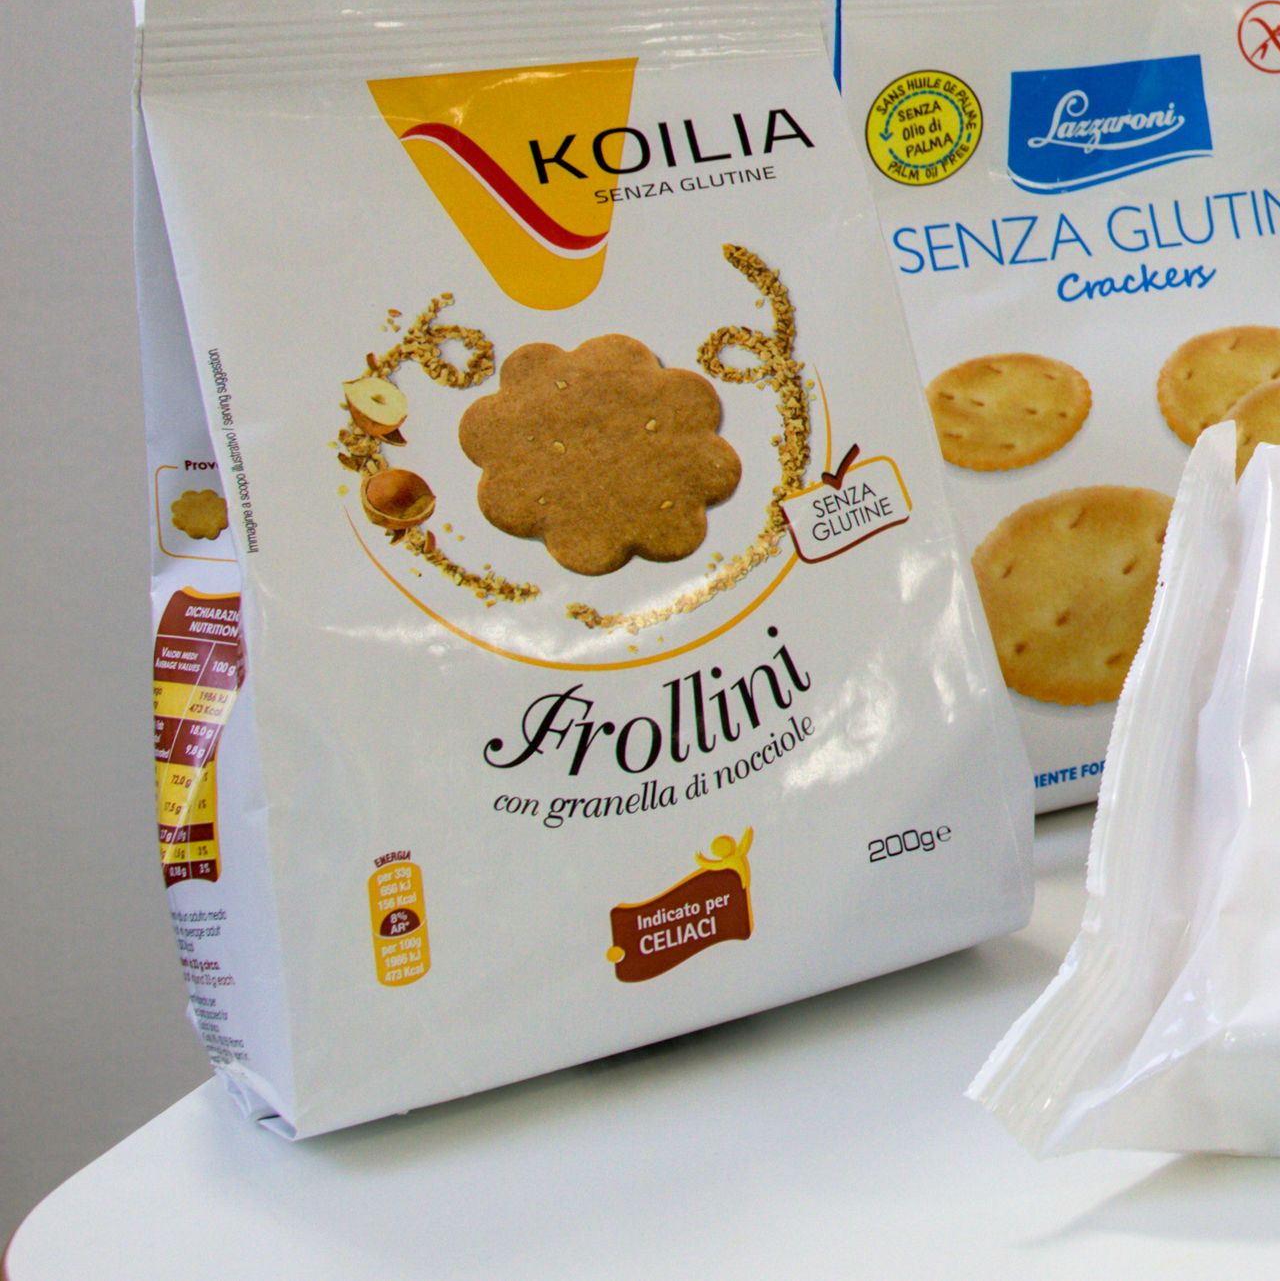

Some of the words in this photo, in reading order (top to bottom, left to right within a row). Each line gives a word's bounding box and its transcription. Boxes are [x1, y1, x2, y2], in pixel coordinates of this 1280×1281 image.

[876, 84, 906, 115] SANS
[907, 76, 942, 91] HUILE
[942, 80, 956, 93] DE
[898, 100, 942, 122] SENZA
[929, 117, 942, 134] di
[1027, 89, 1185, 153] Lazzaroni
[528, 108, 815, 185] KOILIA
[887, 159, 921, 181] PALM
[941, 144, 970, 173] FREE
[905, 132, 954, 159] PALMA
[594, 180, 673, 205] SENZA
[680, 165, 776, 192] GLUTINE
[893, 212, 1092, 275] SENZA
[1057, 262, 1217, 304] Crackers
[812, 482, 877, 519] SENZA
[812, 496, 894, 542] GLUTINE
[484, 625, 812, 777] Frollini
[493, 792, 540, 817] con
[543, 780, 678, 829] granella
[685, 773, 710, 801] di
[714, 715, 817, 790] nocciole
[636, 901, 702, 932] Indicato
[705, 892, 731, 918] per
[638, 917, 718, 957] CELIACI
